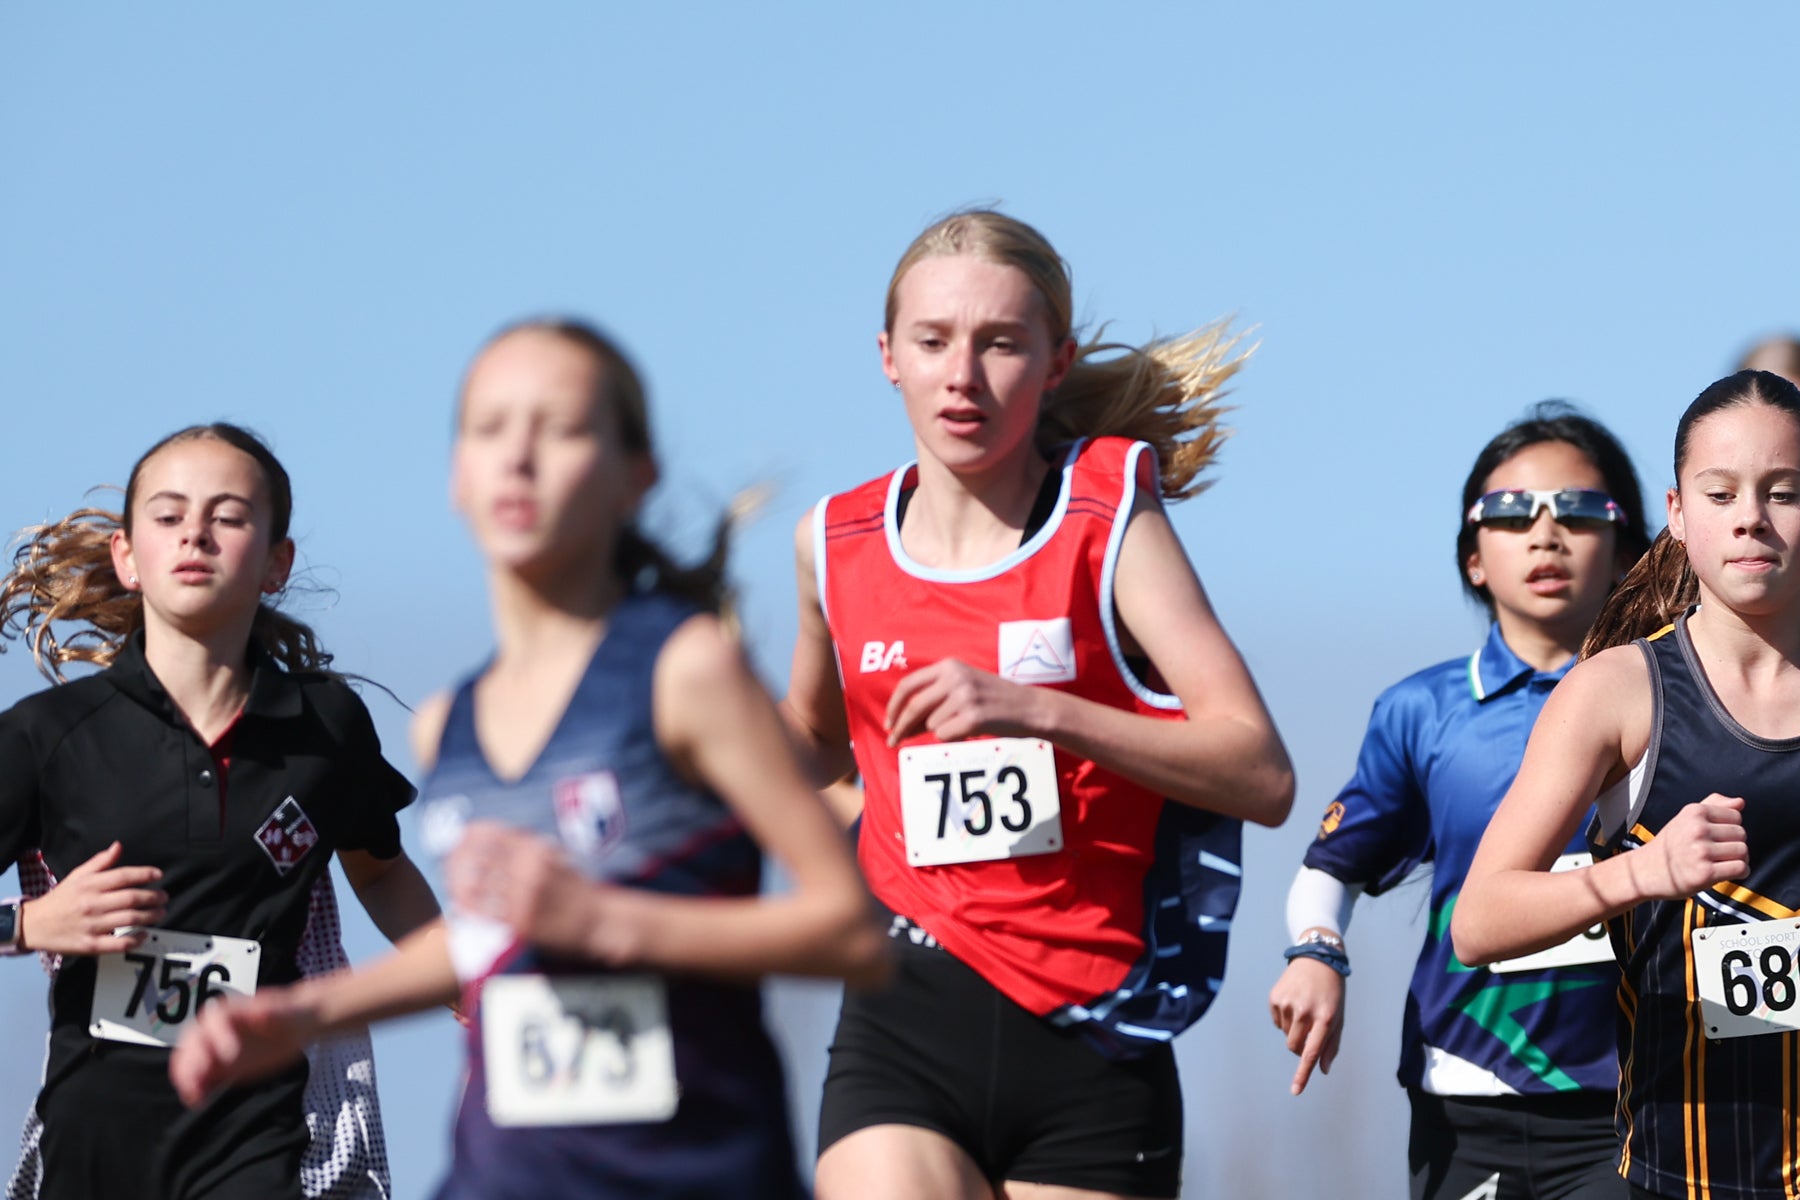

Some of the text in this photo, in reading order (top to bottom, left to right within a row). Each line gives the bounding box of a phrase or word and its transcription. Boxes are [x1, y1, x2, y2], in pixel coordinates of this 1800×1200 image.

[924, 765, 1032, 839] 753
[1720, 931, 1797, 950] SCHOOL SPORT
[124, 952, 231, 1026] 756
